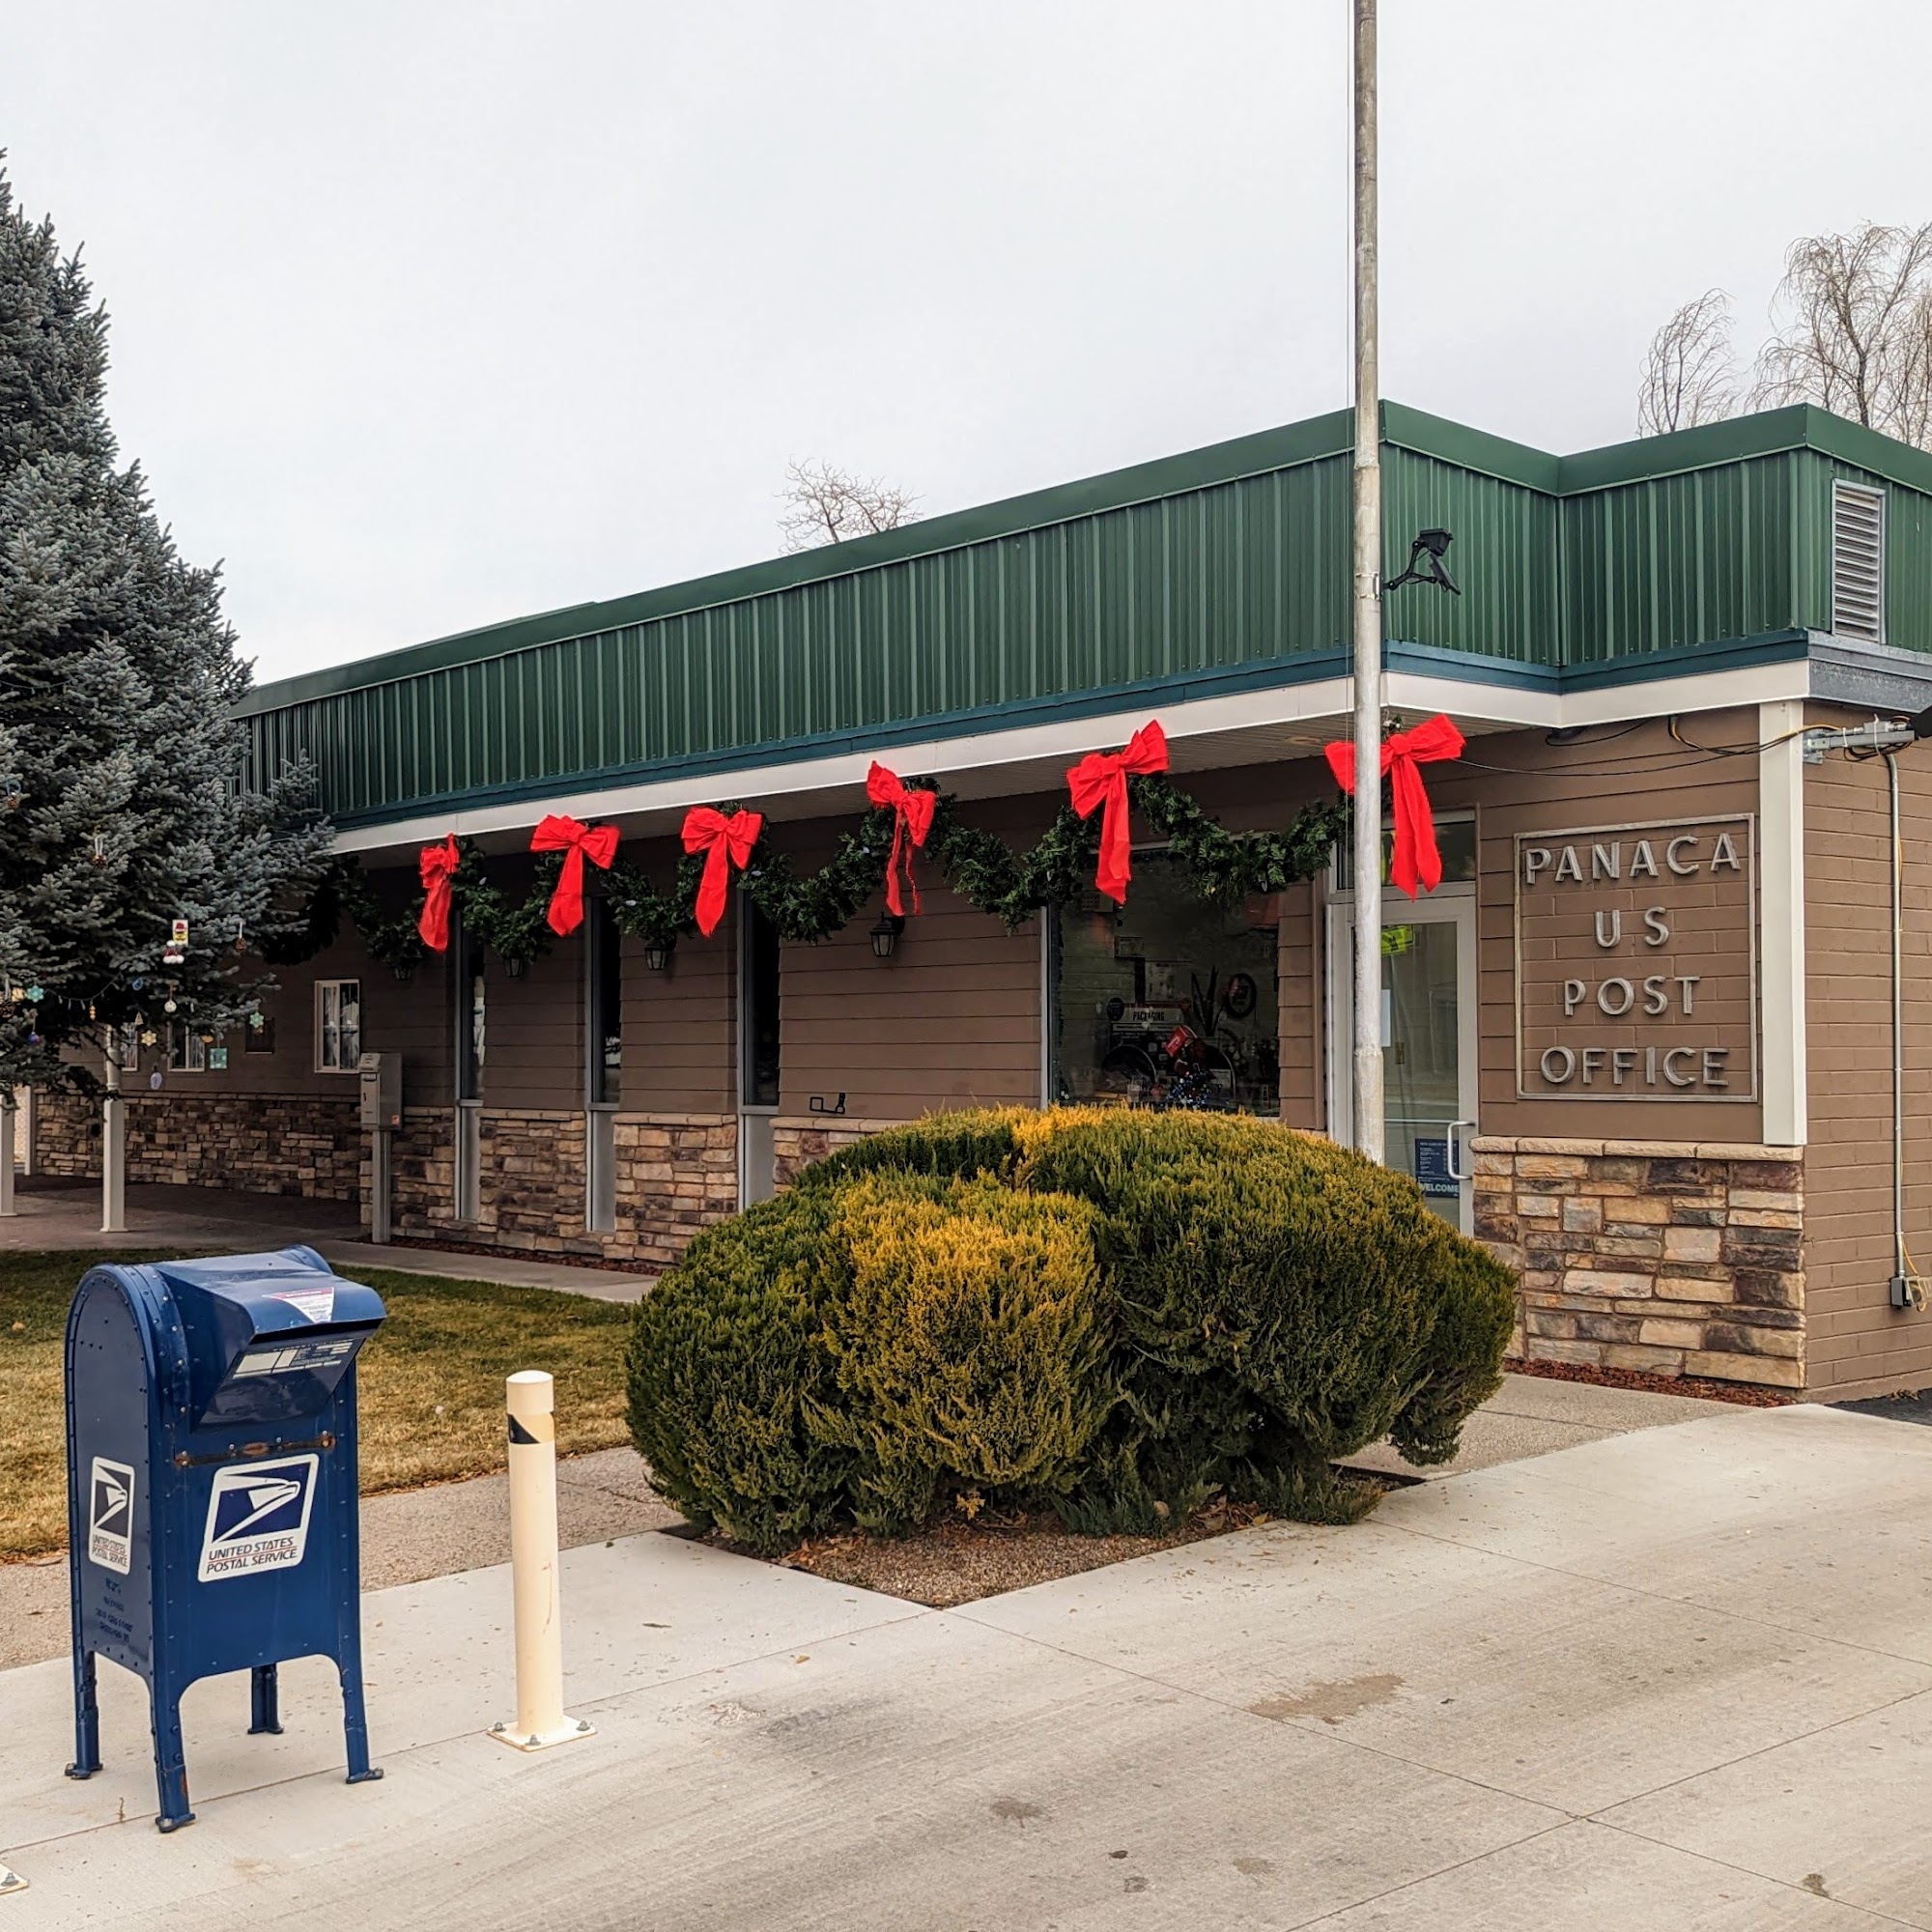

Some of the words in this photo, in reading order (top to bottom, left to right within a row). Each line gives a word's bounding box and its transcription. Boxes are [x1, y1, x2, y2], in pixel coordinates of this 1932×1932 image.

[1525, 832, 1741, 885] PANACA
[1564, 975, 1700, 1016] POST
[1541, 1045, 1729, 1087] OFFICE
[109, 1552, 128, 1567] SERVICE
[206, 1557, 249, 1575] POSTAL
[251, 1548, 298, 1565] SERVICE
[209, 1544, 252, 1560] UNITED
[254, 1536, 294, 1551] STATES
